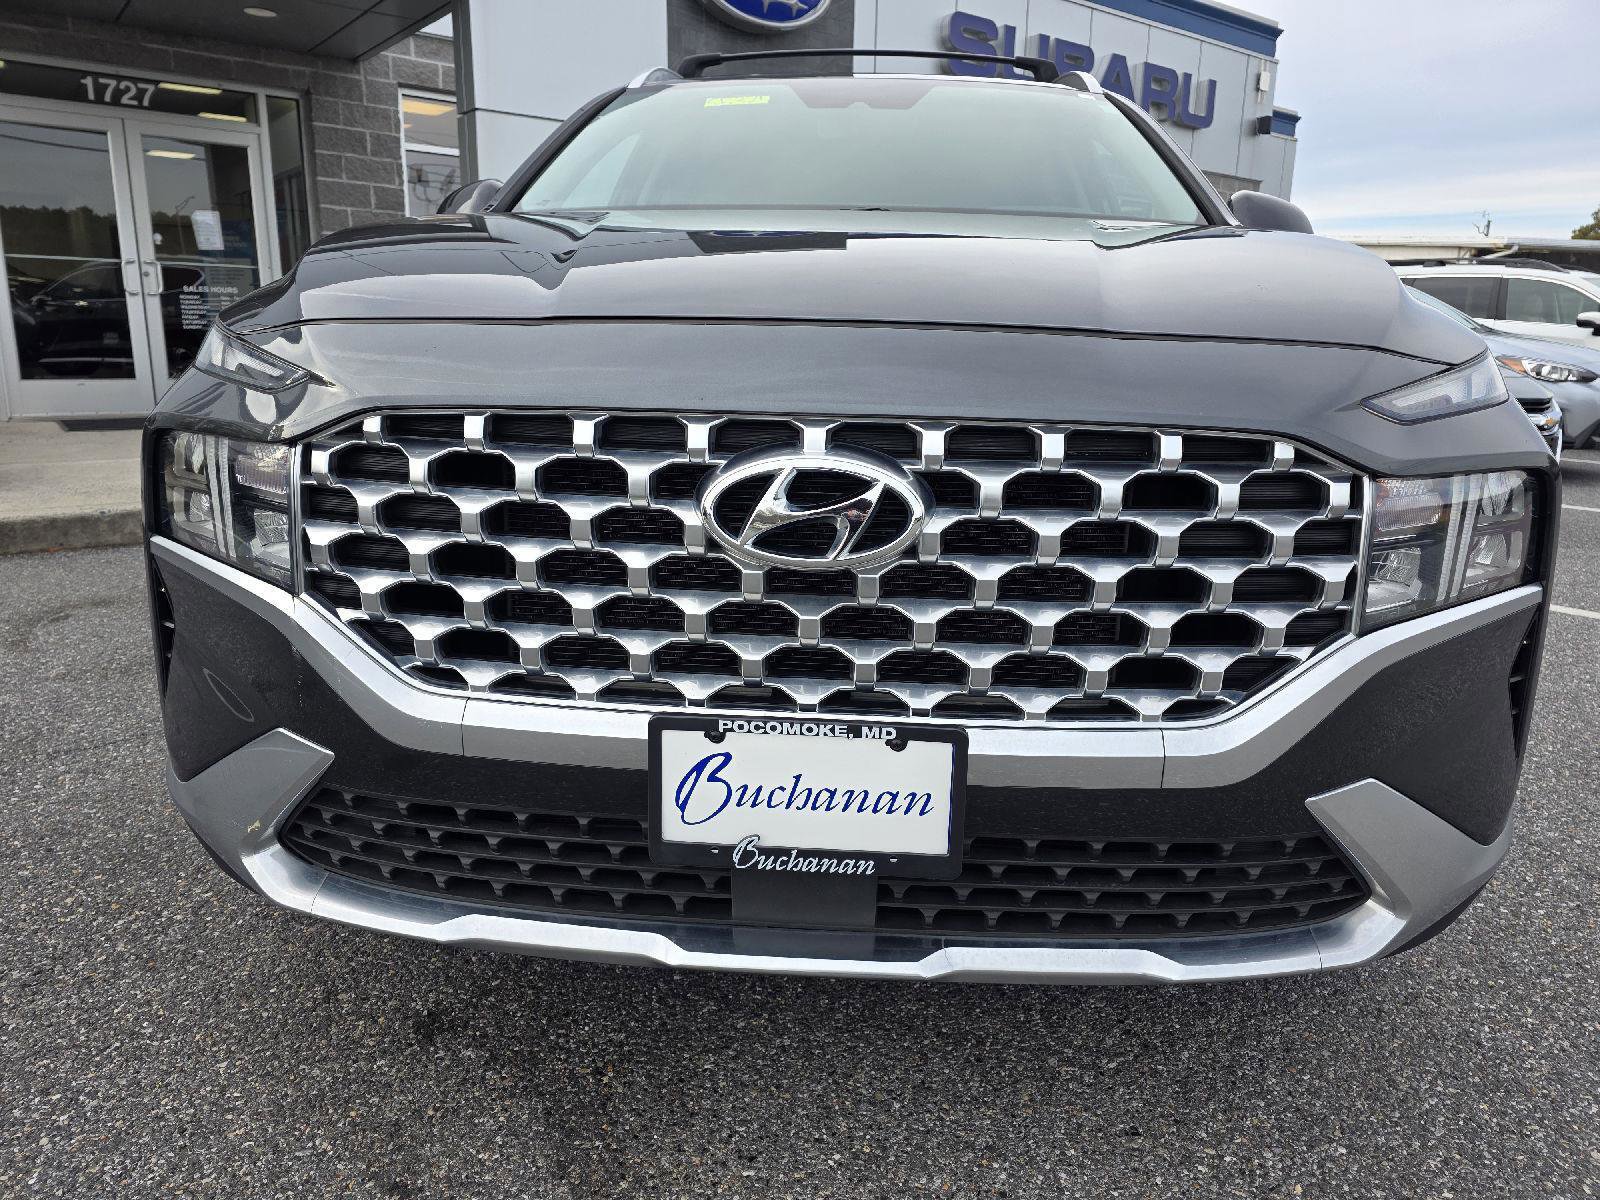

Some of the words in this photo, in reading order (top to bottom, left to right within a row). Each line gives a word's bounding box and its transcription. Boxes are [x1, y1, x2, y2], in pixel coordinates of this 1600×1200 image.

[941, 11, 1217, 129] SUBARU
[80, 76, 155, 107] 1727
[718, 720, 854, 740] POCOMOKE,
[861, 727, 897, 740] MD
[674, 751, 935, 826] Buchanan
[732, 834, 876, 875] Buchanan
